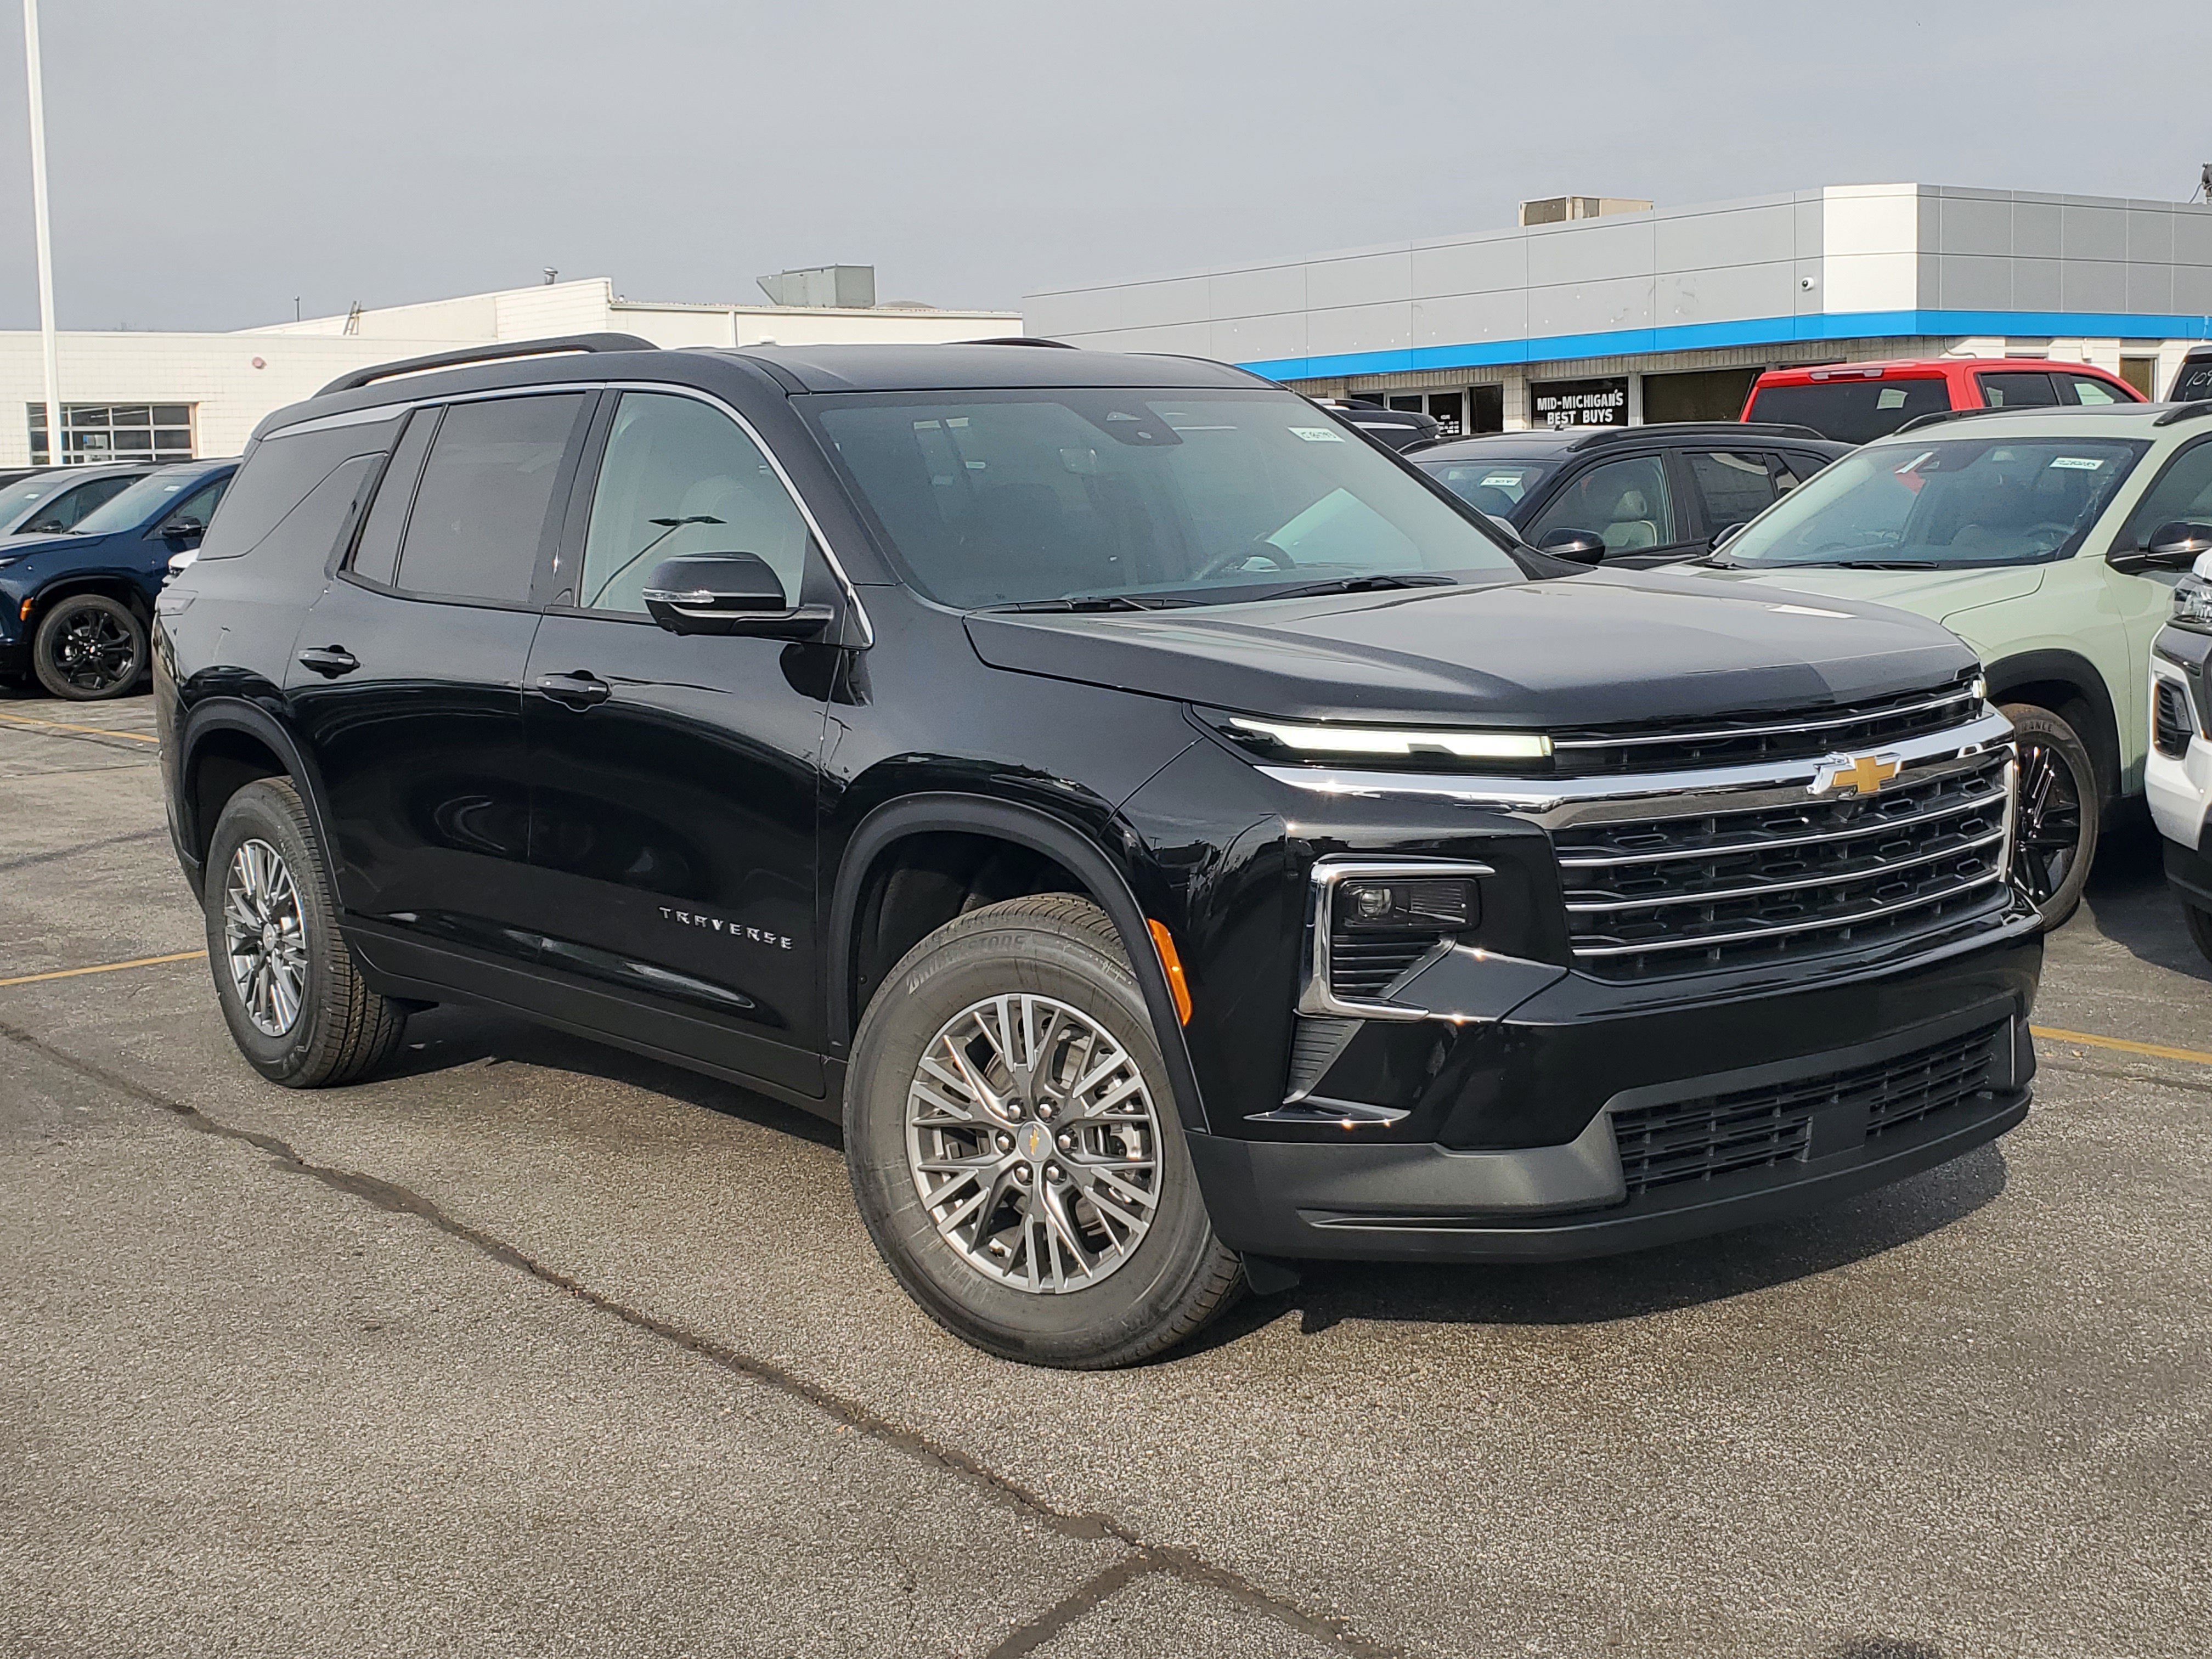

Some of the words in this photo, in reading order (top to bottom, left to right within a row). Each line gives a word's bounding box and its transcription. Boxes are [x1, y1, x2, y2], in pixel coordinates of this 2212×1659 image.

[1537, 389, 1623, 411] MID-MICHIGAN'S
[1547, 410, 1576, 425] BEST
[1582, 408, 1613, 423] BUYS
[659, 907, 792, 949] TRAVERSE
